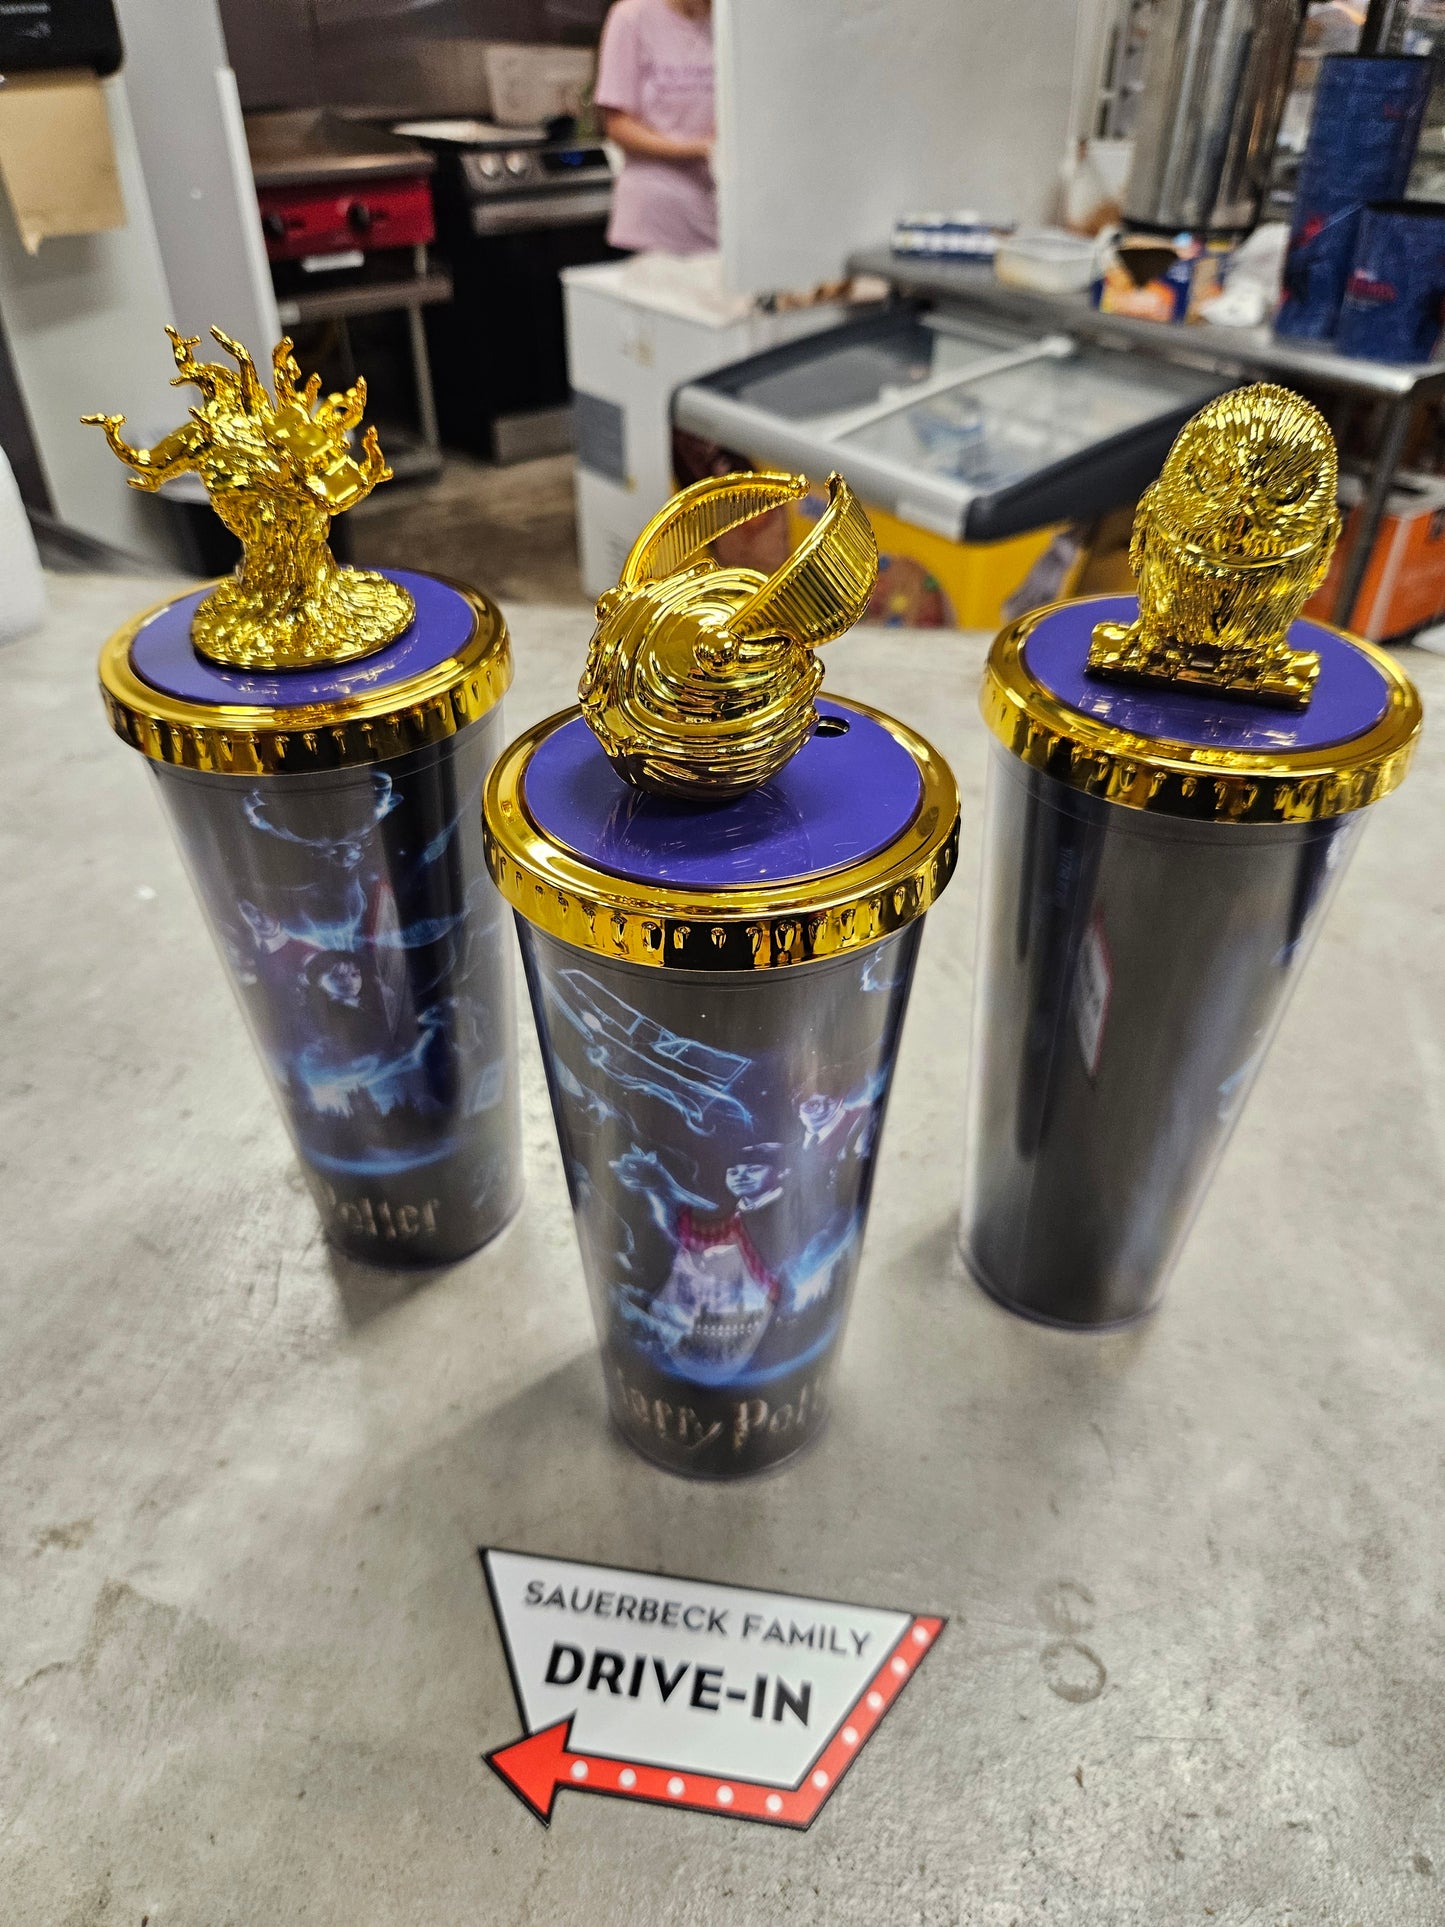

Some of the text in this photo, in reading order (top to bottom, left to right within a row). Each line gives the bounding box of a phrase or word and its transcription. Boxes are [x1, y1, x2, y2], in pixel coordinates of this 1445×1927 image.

[524, 1580, 873, 1658] SAUERBECK FAMILY
[543, 1640, 813, 1727] DRIVE-IN
